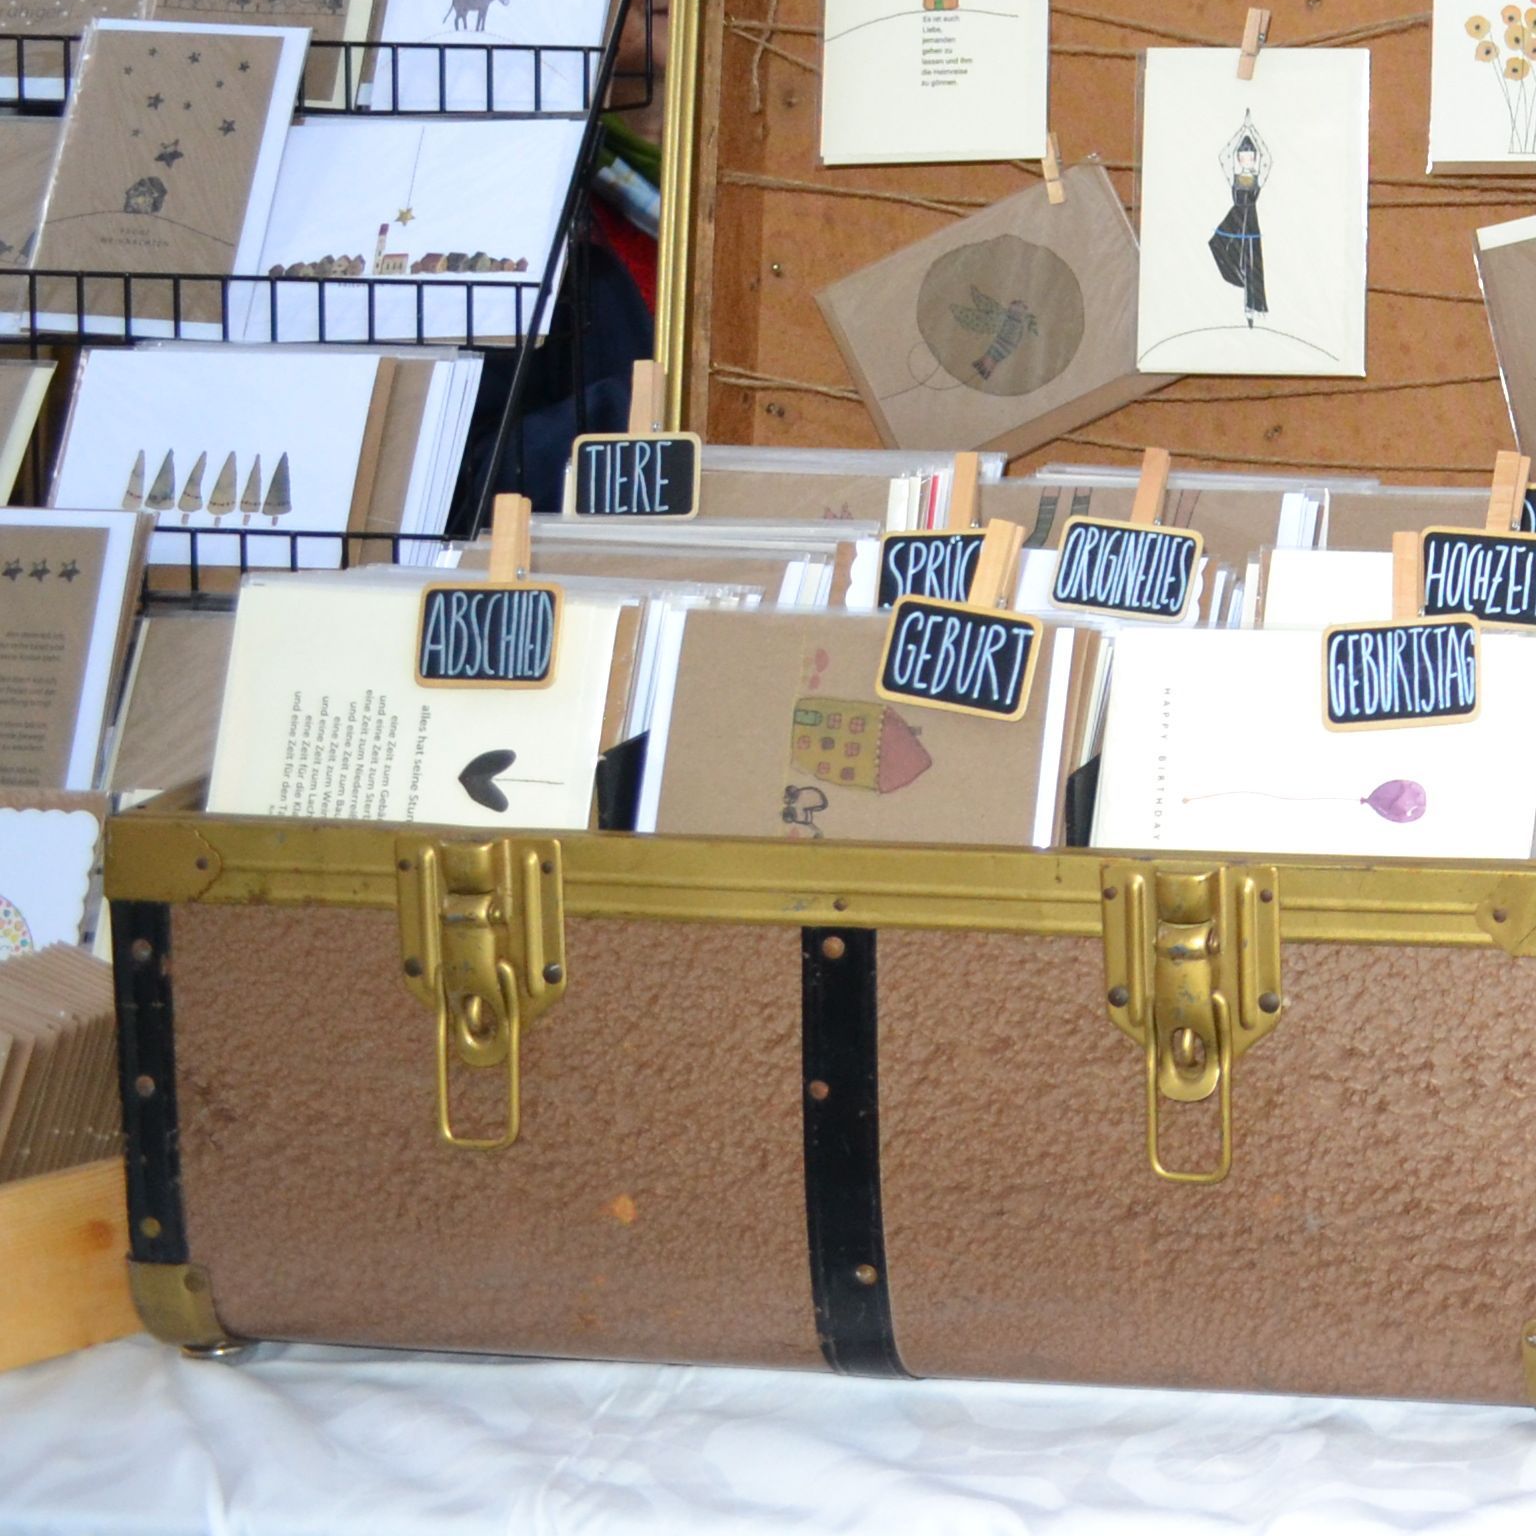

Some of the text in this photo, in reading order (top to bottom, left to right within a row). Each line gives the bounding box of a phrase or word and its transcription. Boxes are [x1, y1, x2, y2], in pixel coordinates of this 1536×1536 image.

[585, 441, 672, 514] TIERE
[882, 534, 980, 608] SPRÜC
[1056, 526, 1195, 613] ORIGINELLES
[421, 590, 555, 679] ABSCHIED
[893, 611, 1035, 705] GEBURT
[1328, 626, 1476, 717] GEBURTSTAG
[292, 690, 302, 712] und
[320, 695, 329, 717] und
[347, 701, 357, 722] und
[363, 689, 373, 712] eine
[377, 695, 387, 717] und
[289, 714, 299, 738] eine
[302, 714, 313, 739] eine
[330, 716, 341, 740] eine
[360, 714, 372, 735] Zeit
[374, 718, 384, 742] eine
[389, 715, 398, 739] eine
[419, 704, 431, 733] alles
[316, 718, 326, 743] eine
[344, 724, 354, 748] eine
[285, 739, 297, 760] Zeit
[299, 740, 311, 762] Zeit
[313, 744, 325, 765] Zeit
[327, 741, 339, 763] Zeit
[357, 738, 367, 760] zum
[370, 744, 382, 765] Zeit
[385, 740, 397, 761] Zeit
[415, 735, 428, 755] hat
[340, 750, 352, 771] Zeit
[310, 768, 320, 791] zum
[324, 765, 334, 788] zum
[337, 773, 347, 796] zum
[367, 767, 377, 790] zum
[382, 764, 392, 787] zum
[410, 758, 422, 791] seine
[280, 780, 291, 802] den
[294, 782, 305, 799] die
